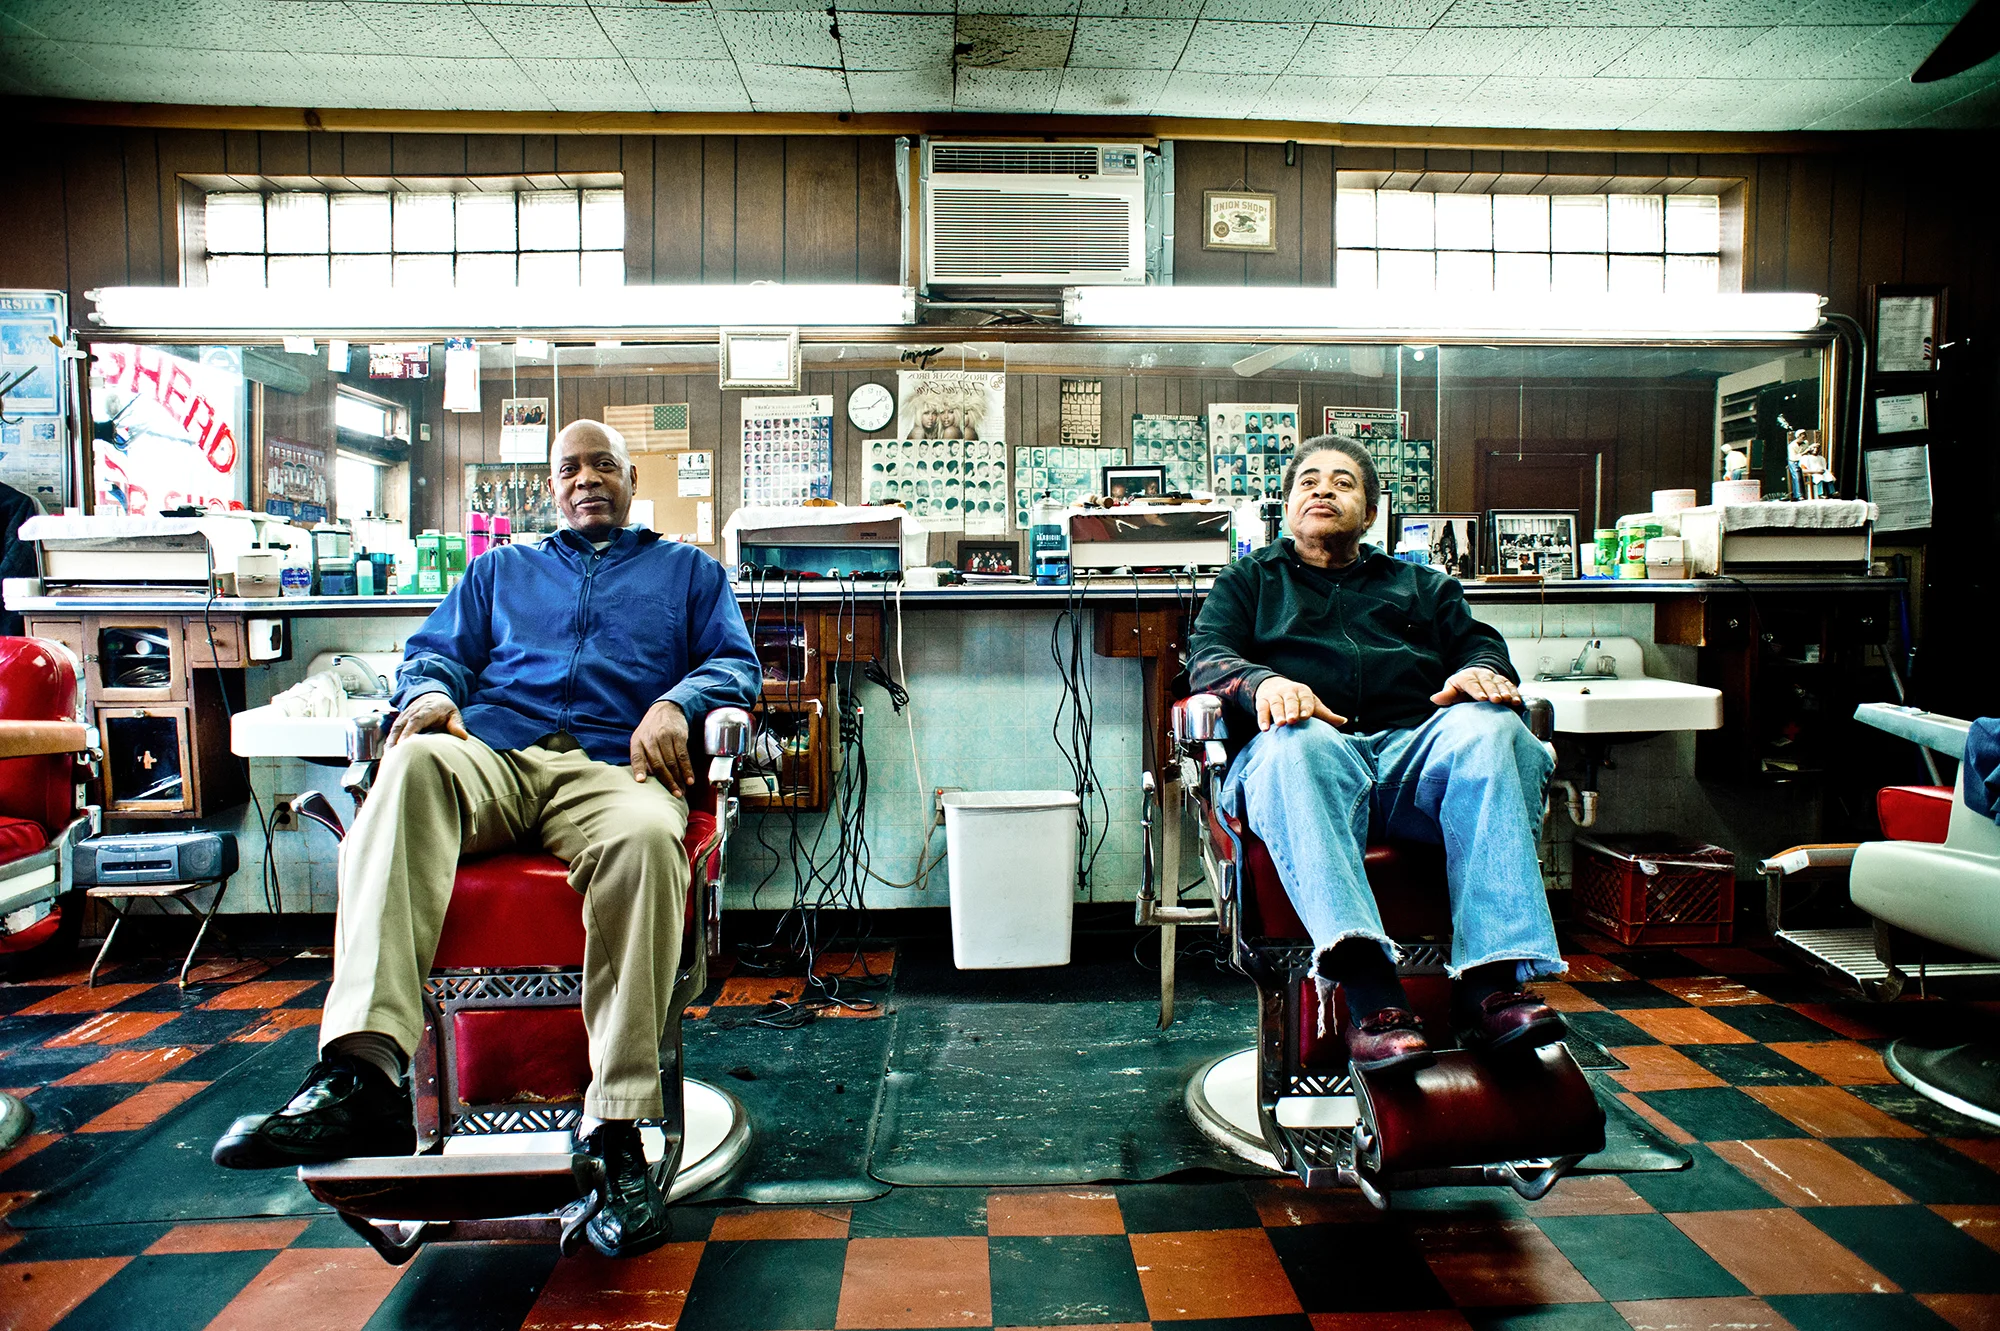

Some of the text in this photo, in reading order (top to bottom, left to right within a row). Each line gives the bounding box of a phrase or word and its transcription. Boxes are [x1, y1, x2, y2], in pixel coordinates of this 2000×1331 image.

[1213, 201, 1267, 216] UNION SHOP!
[901, 347, 944, 370] image
